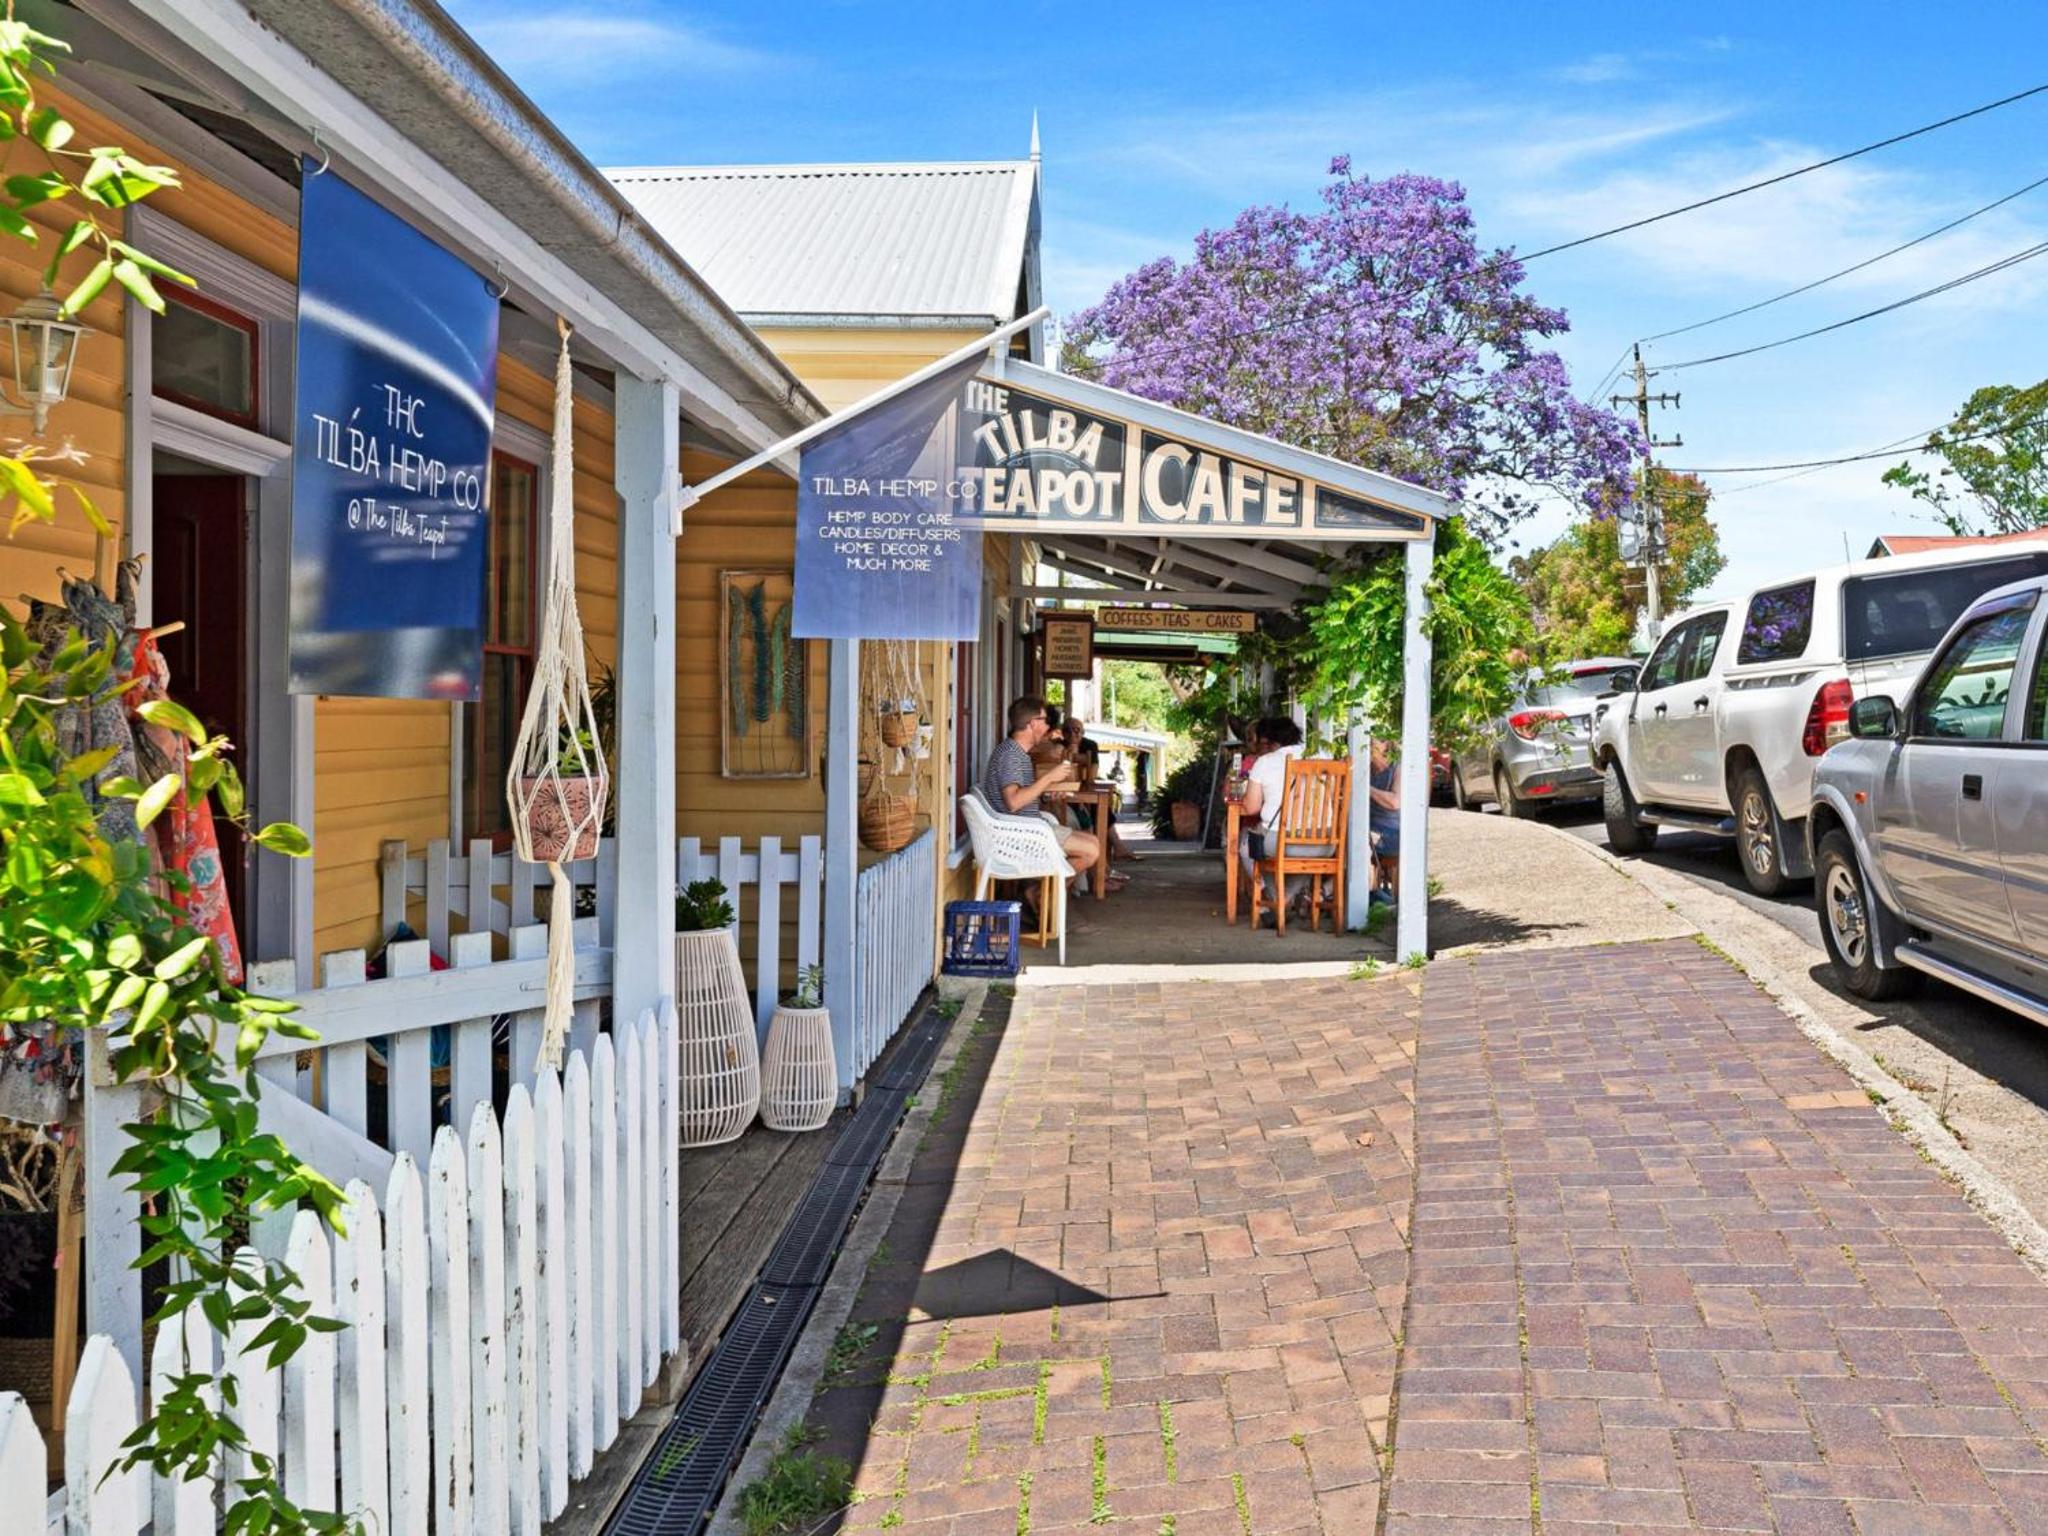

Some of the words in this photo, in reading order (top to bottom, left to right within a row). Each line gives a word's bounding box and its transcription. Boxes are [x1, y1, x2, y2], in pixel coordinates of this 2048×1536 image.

[384, 384, 426, 438] THC
[966, 380, 1010, 415] THE
[972, 409, 1104, 468] TILBA
[313, 413, 381, 479] TILBA
[390, 444, 446, 498] HEMP
[454, 470, 482, 514] CO.
[813, 477, 870, 497] TILBA
[880, 479, 937, 498] HEMP
[946, 481, 981, 500] CO.
[958, 466, 1122, 517] TEAPOT
[1142, 443, 1298, 525] CAFE
[818, 526, 961, 541] CANDLES/DIFFUSERS
[828, 511, 866, 523] HEMP
[872, 512, 910, 524] BODY
[917, 513, 953, 525] CARE
[416, 514, 449, 560] Teapot
[834, 542, 874, 555] HOME
[881, 543, 929, 556] DECOR
[934, 544, 943, 556] &
[846, 557, 886, 570] MUCH
[892, 558, 932, 571] MORE
[1103, 611, 1153, 626] COFFEES
[1159, 612, 1190, 627] TEAS
[1205, 613, 1244, 629] CAKES
